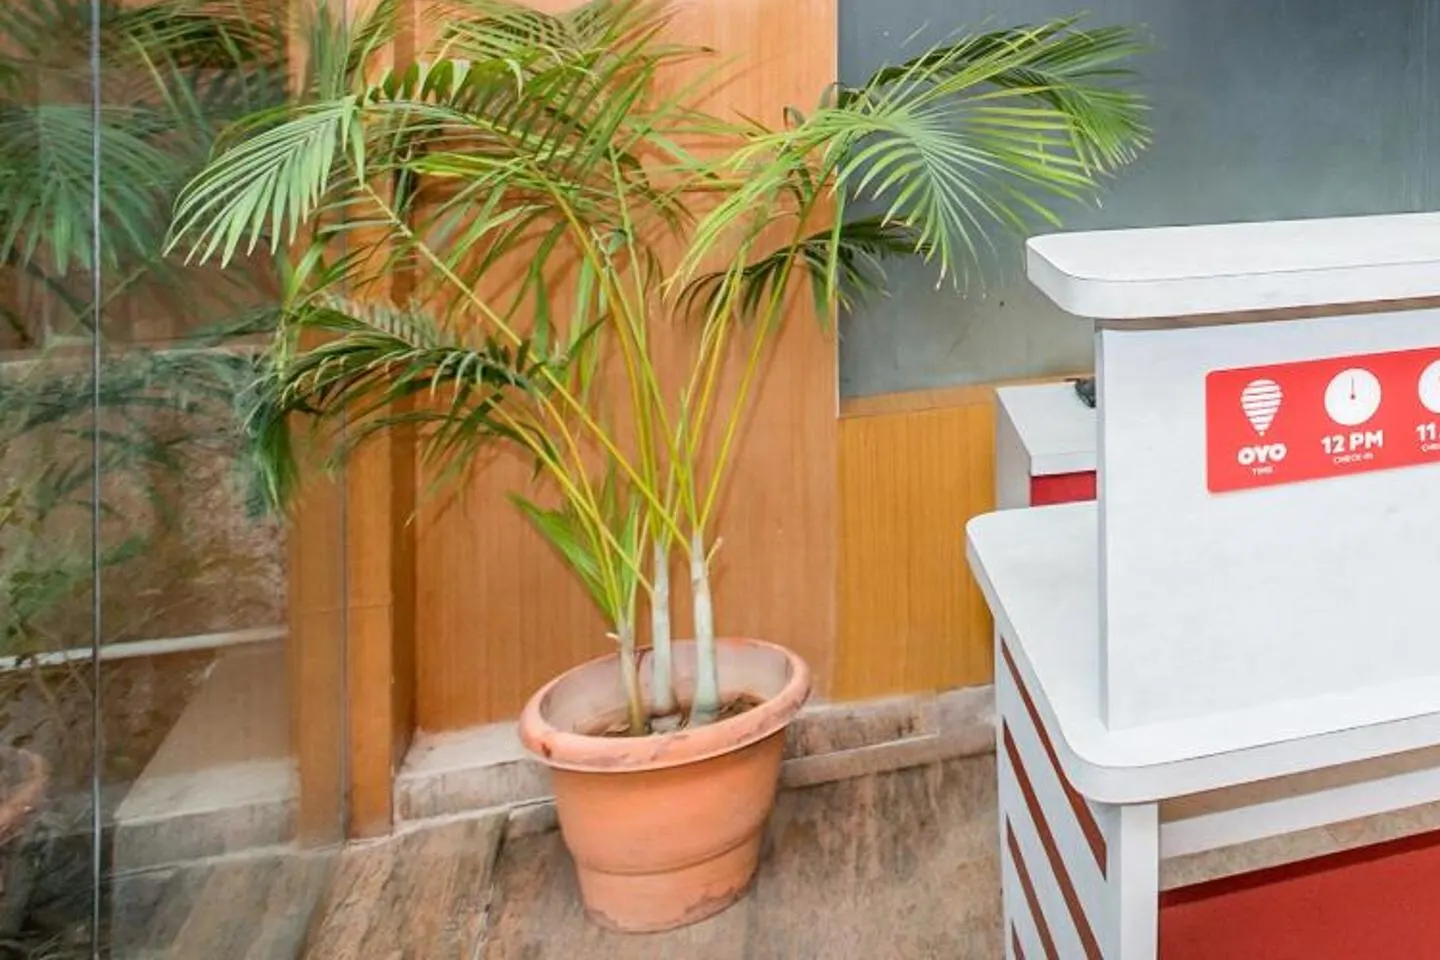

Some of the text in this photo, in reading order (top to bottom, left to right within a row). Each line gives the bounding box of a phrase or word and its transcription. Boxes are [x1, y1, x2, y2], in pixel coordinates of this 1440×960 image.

[1321, 430, 1383, 454] 12 PM
[1416, 422, 1436, 441] 11
[1238, 443, 1287, 465] OYO
